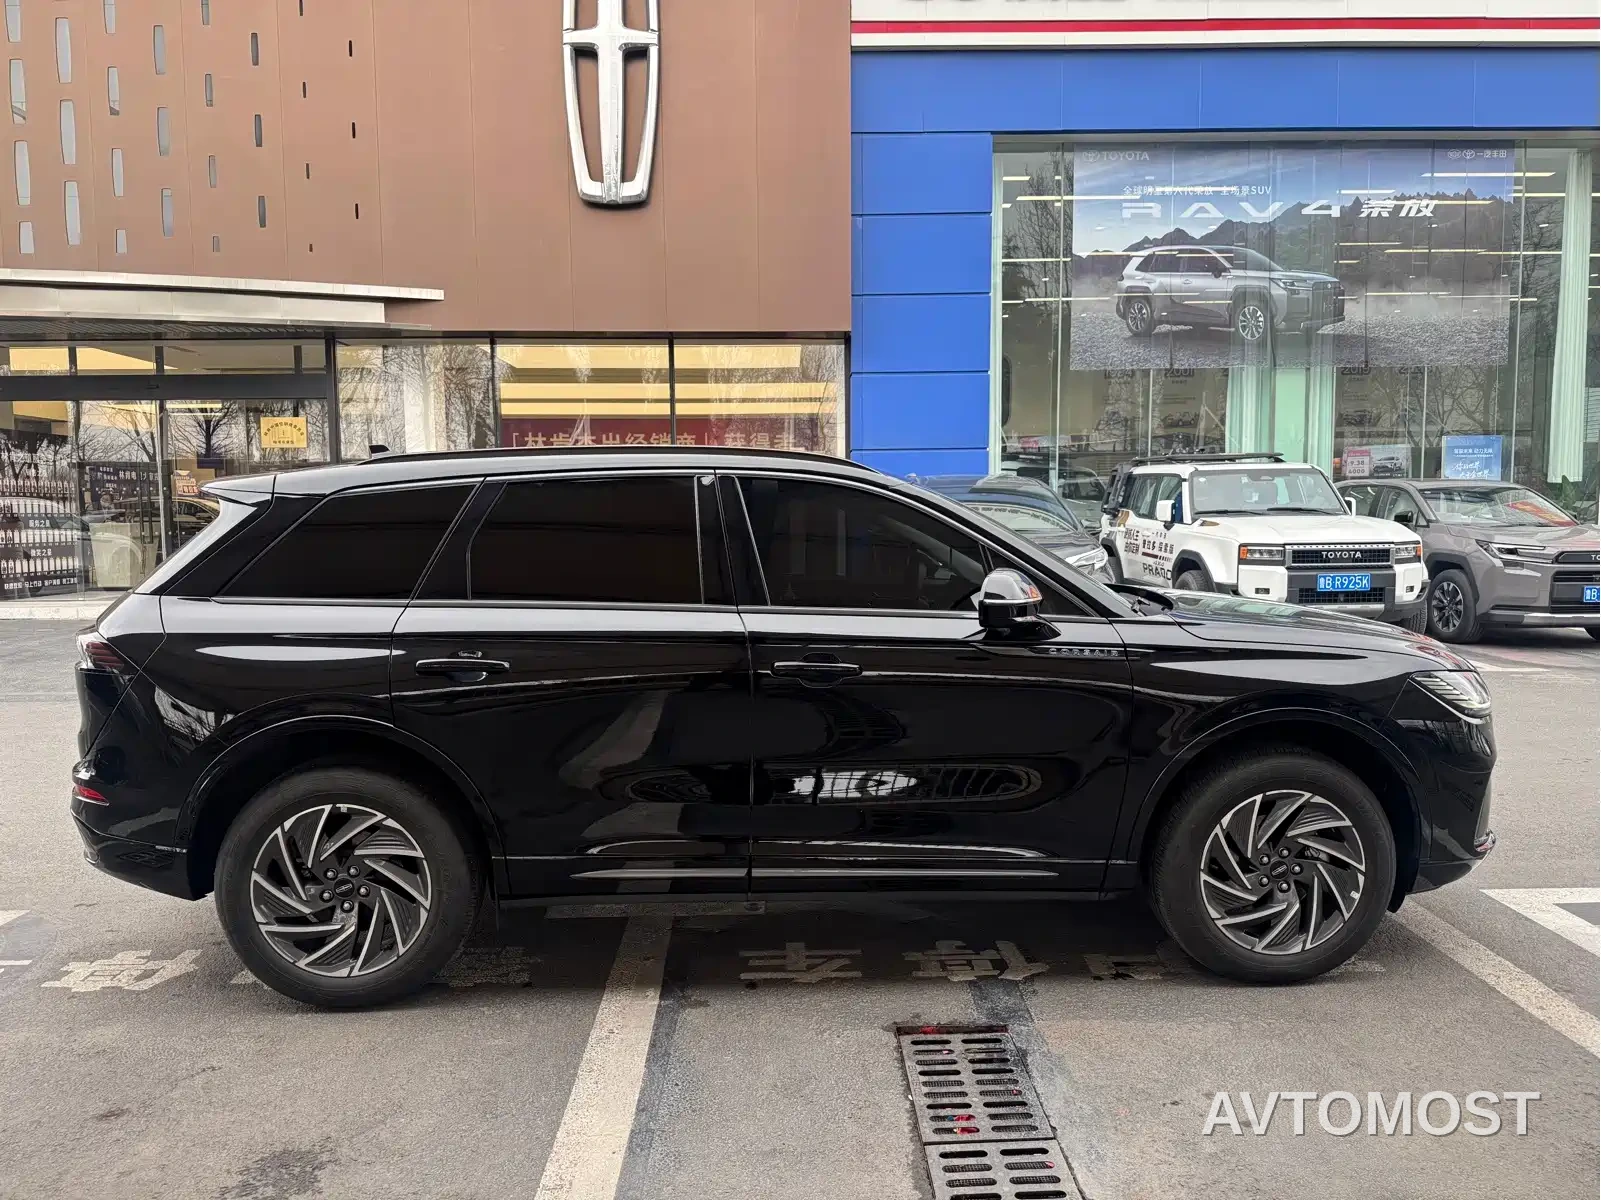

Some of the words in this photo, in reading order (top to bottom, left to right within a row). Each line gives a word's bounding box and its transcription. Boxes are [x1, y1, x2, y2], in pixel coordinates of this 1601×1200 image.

[1103, 150, 1150, 161] TOYOTA
[1122, 201, 1341, 218] RAV4
[1358, 199, 1439, 218] 荣放
[1321, 551, 1362, 559] TOYOTA
